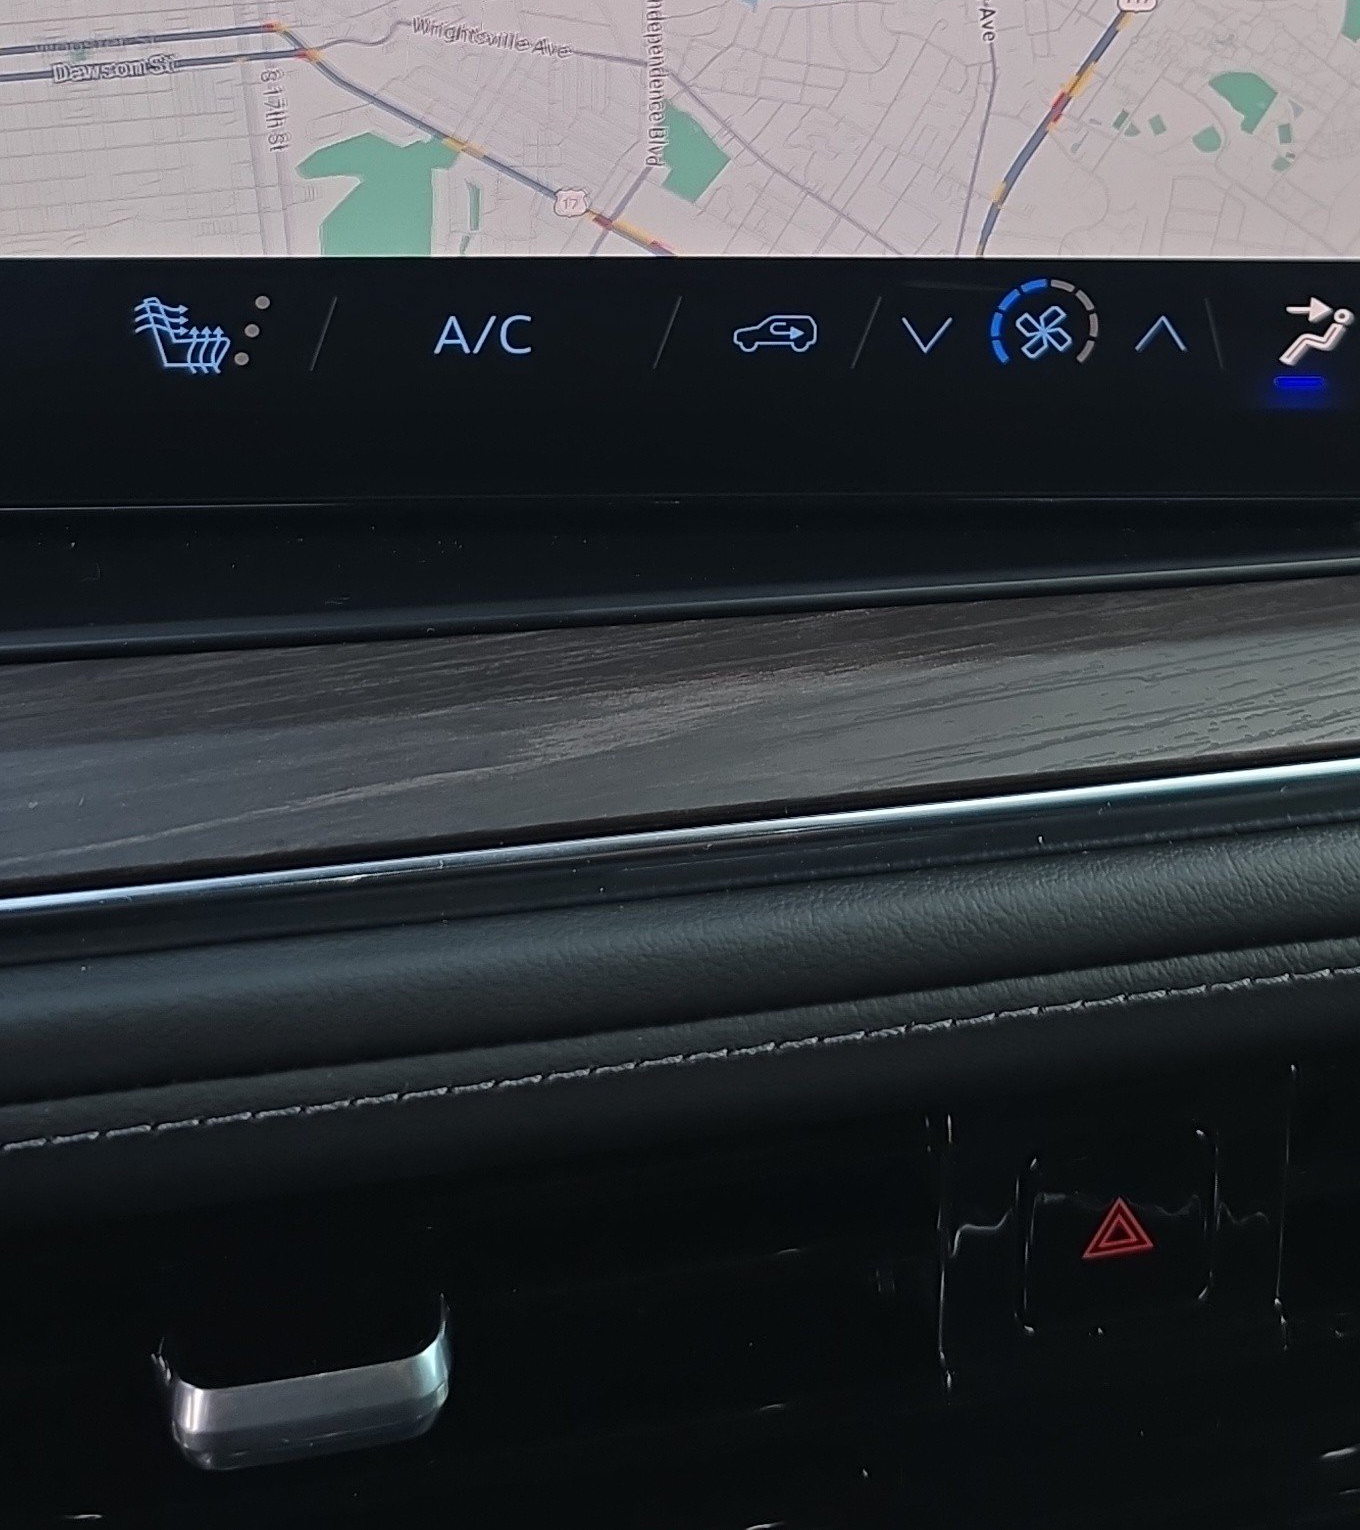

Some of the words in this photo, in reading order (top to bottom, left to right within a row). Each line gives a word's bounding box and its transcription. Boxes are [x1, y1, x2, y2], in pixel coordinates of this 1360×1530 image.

[979, 8, 996, 42] Ave
[531, 38, 573, 59] Ave
[52, 58, 148, 83] Dawson
[148, 54, 176, 73] St
[646, 127, 668, 167] Blvd
[561, 198, 578, 210] 17
[434, 315, 533, 355] A/C
